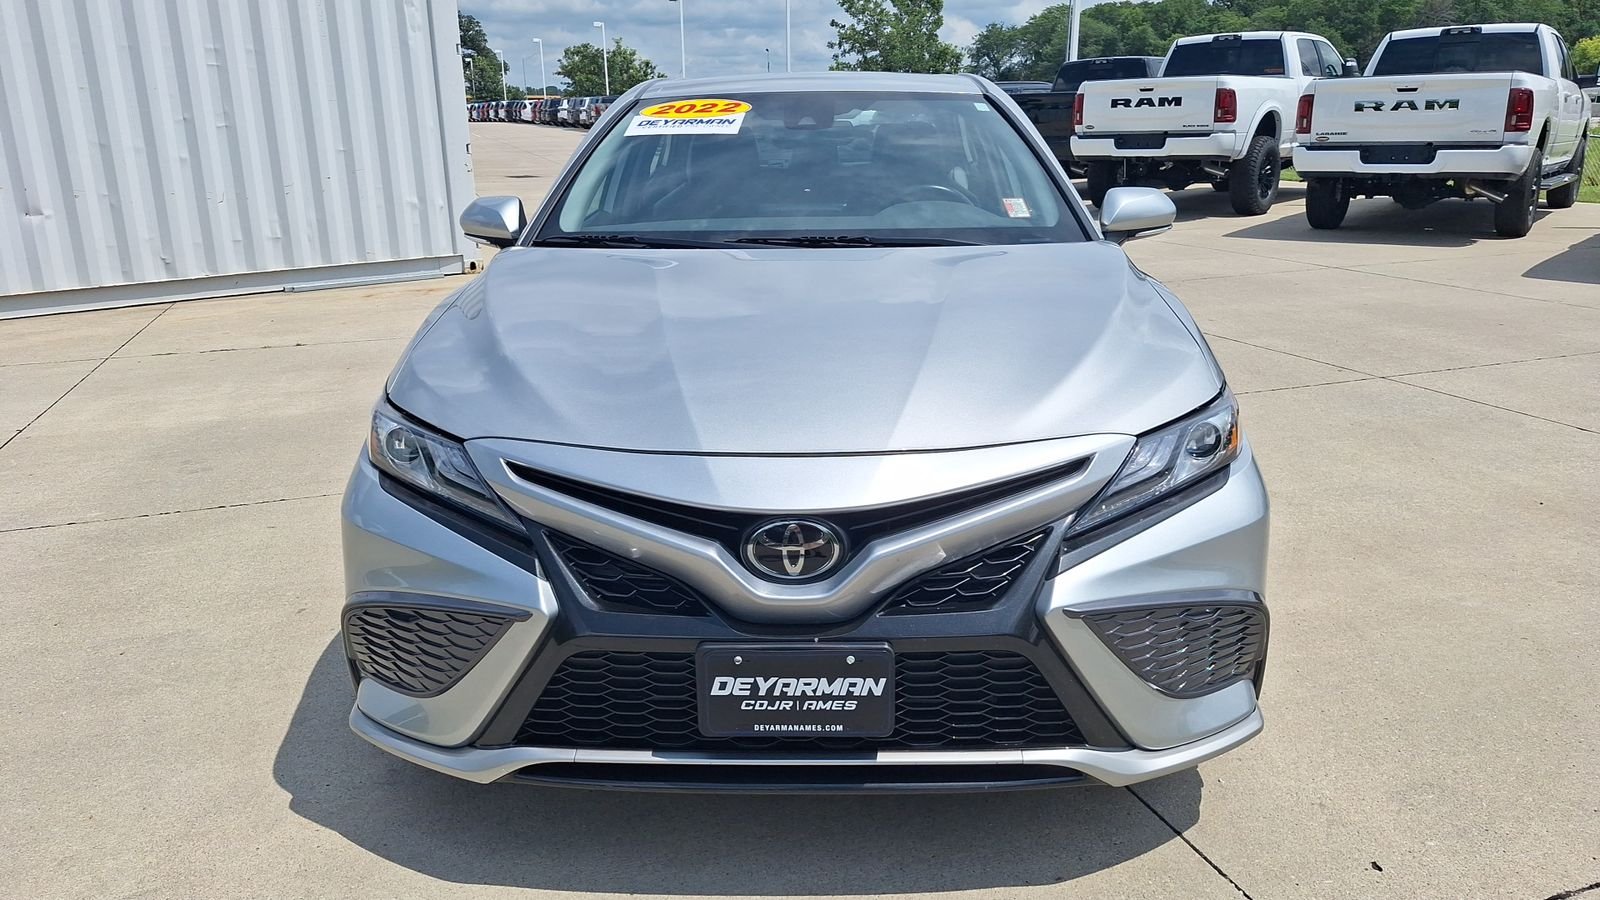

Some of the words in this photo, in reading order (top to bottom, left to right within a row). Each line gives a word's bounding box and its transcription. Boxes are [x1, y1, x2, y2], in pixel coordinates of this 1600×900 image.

[652, 102, 742, 115] 2022
[1111, 96, 1183, 109] RAM
[1353, 98, 1461, 112] RAM
[637, 118, 738, 127] DEYARMAN
[710, 676, 887, 697] DEYARMAN
[740, 700, 792, 711] CDJR
[802, 700, 859, 711] AMES
[754, 724, 844, 732] DEYARMANAMES.COM
